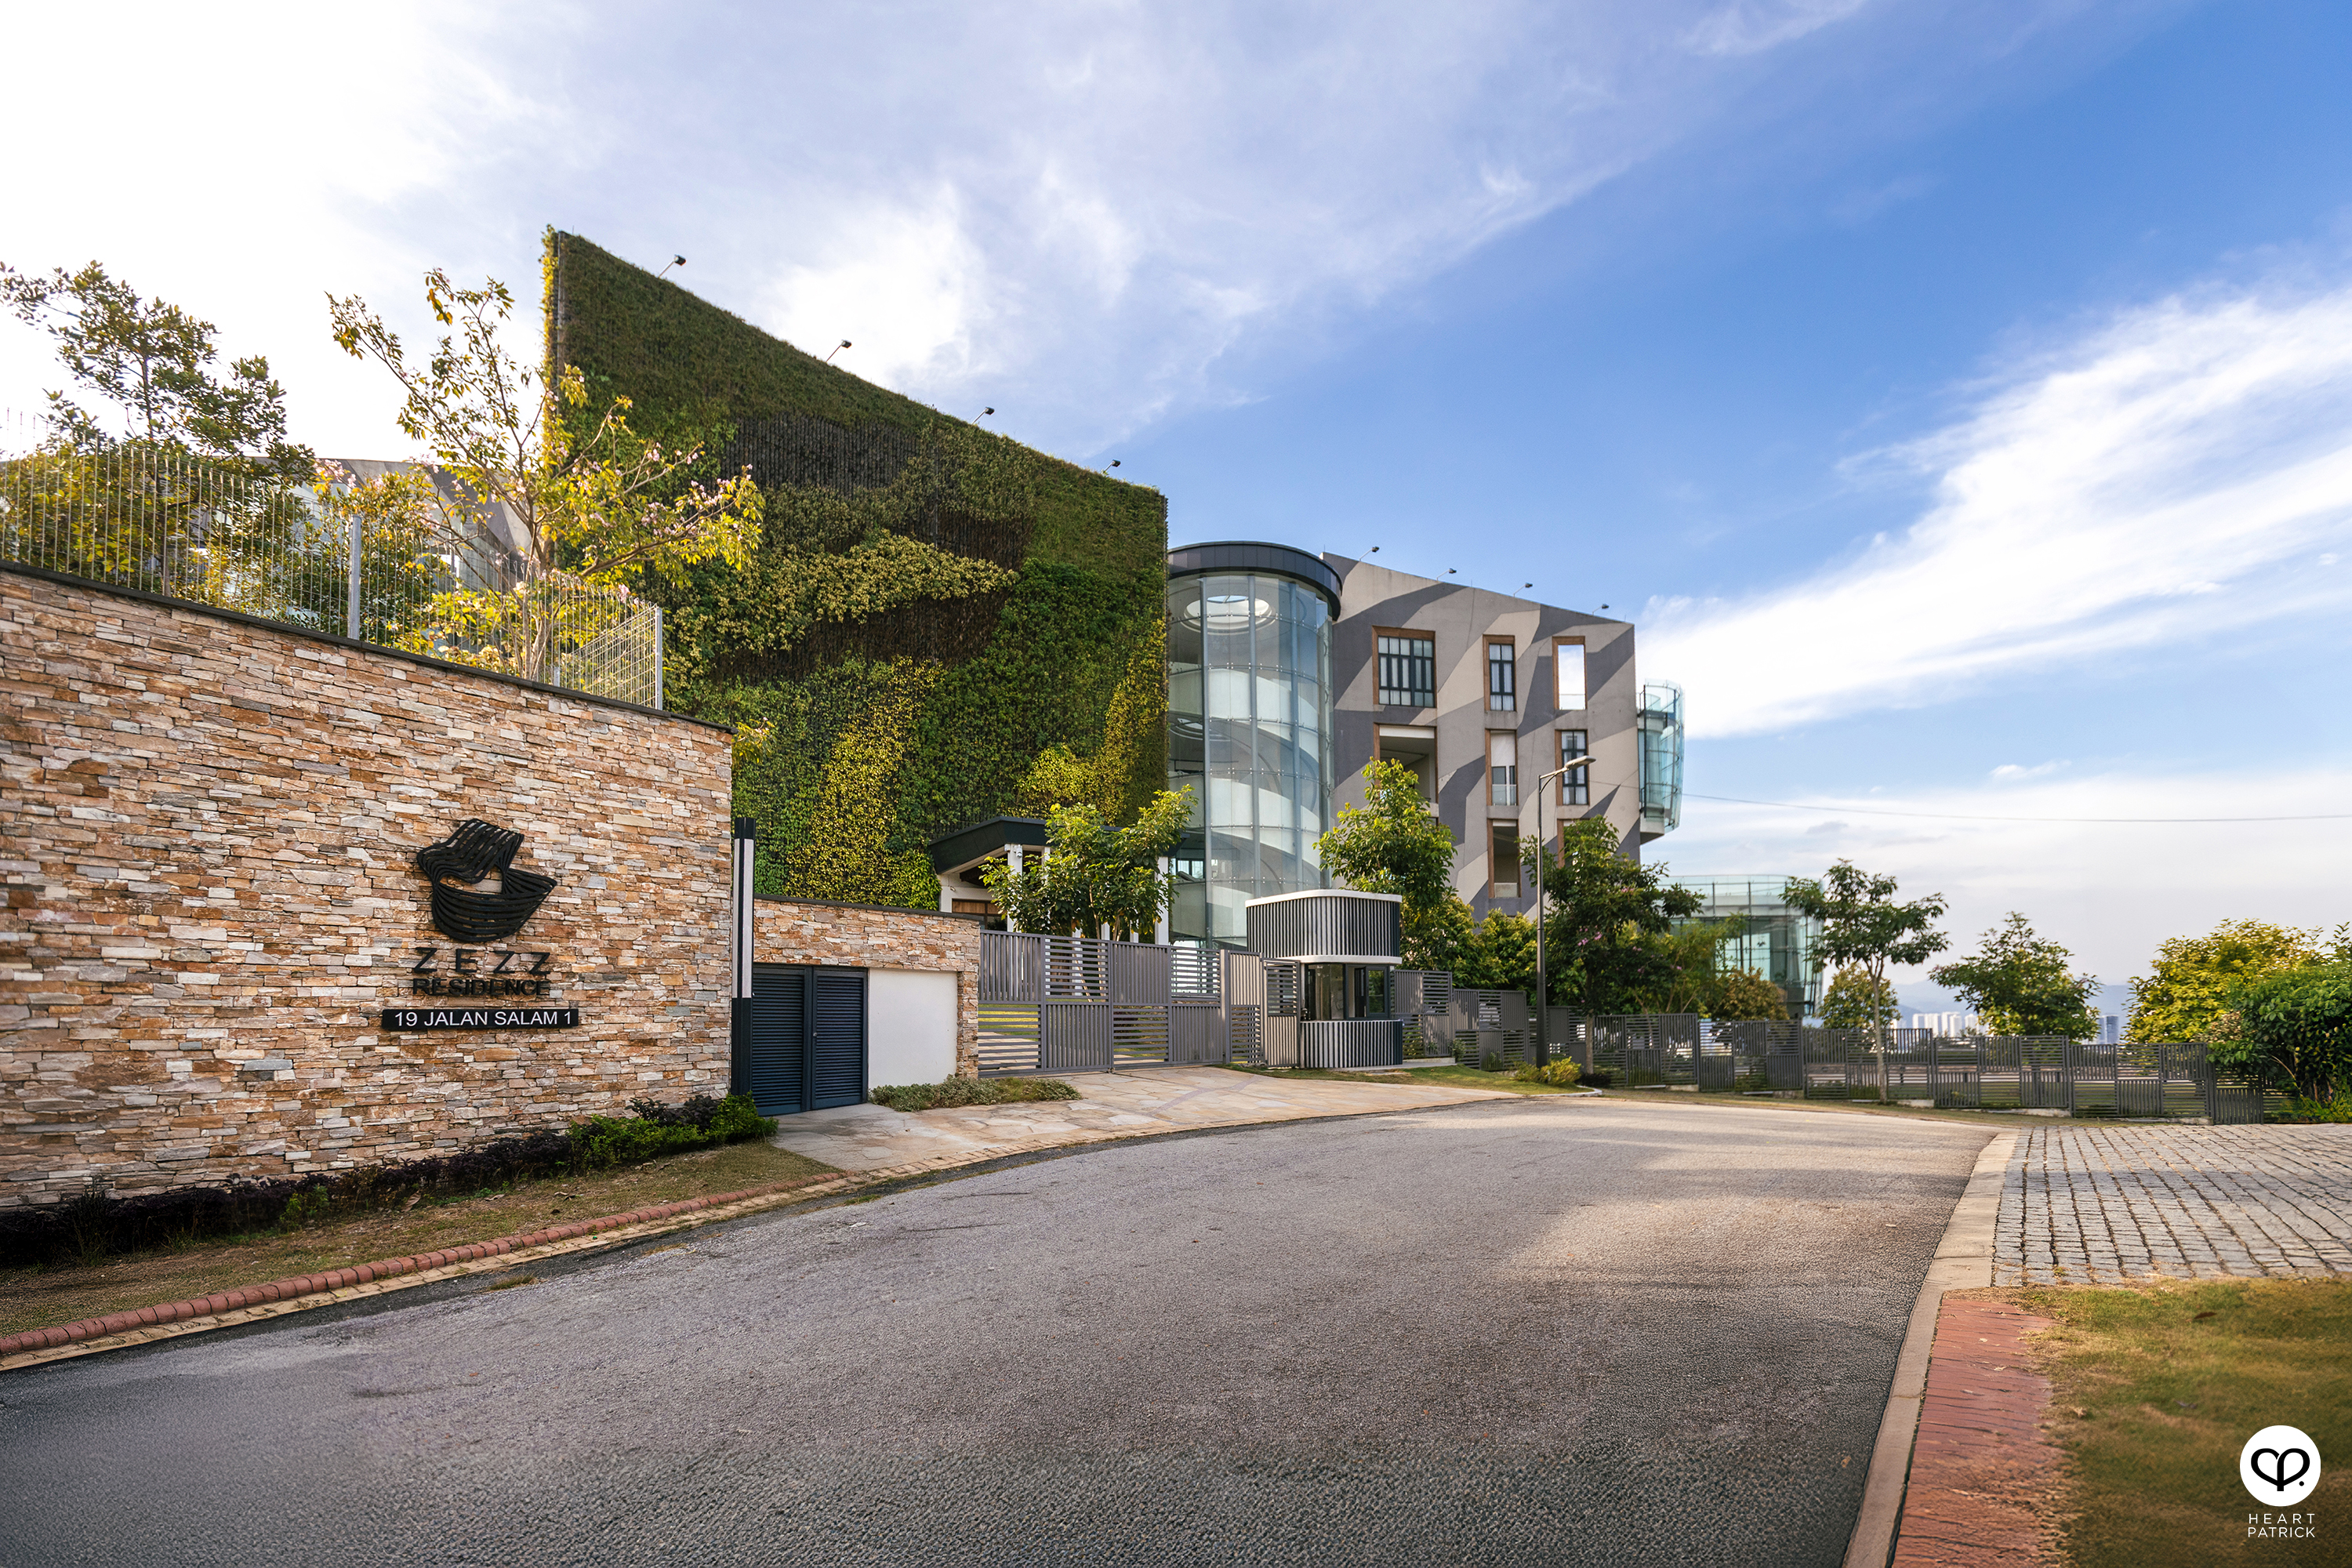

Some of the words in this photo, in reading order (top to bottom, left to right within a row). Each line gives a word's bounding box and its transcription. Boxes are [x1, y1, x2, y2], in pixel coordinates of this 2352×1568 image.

[413, 947, 550, 975] ZEZZ
[412, 978, 550, 996] RESIDENCE
[394, 1012, 418, 1026] 19
[423, 1011, 488, 1026] JALAN
[494, 1011, 558, 1025] SALAM
[564, 1011, 572, 1025] 1
